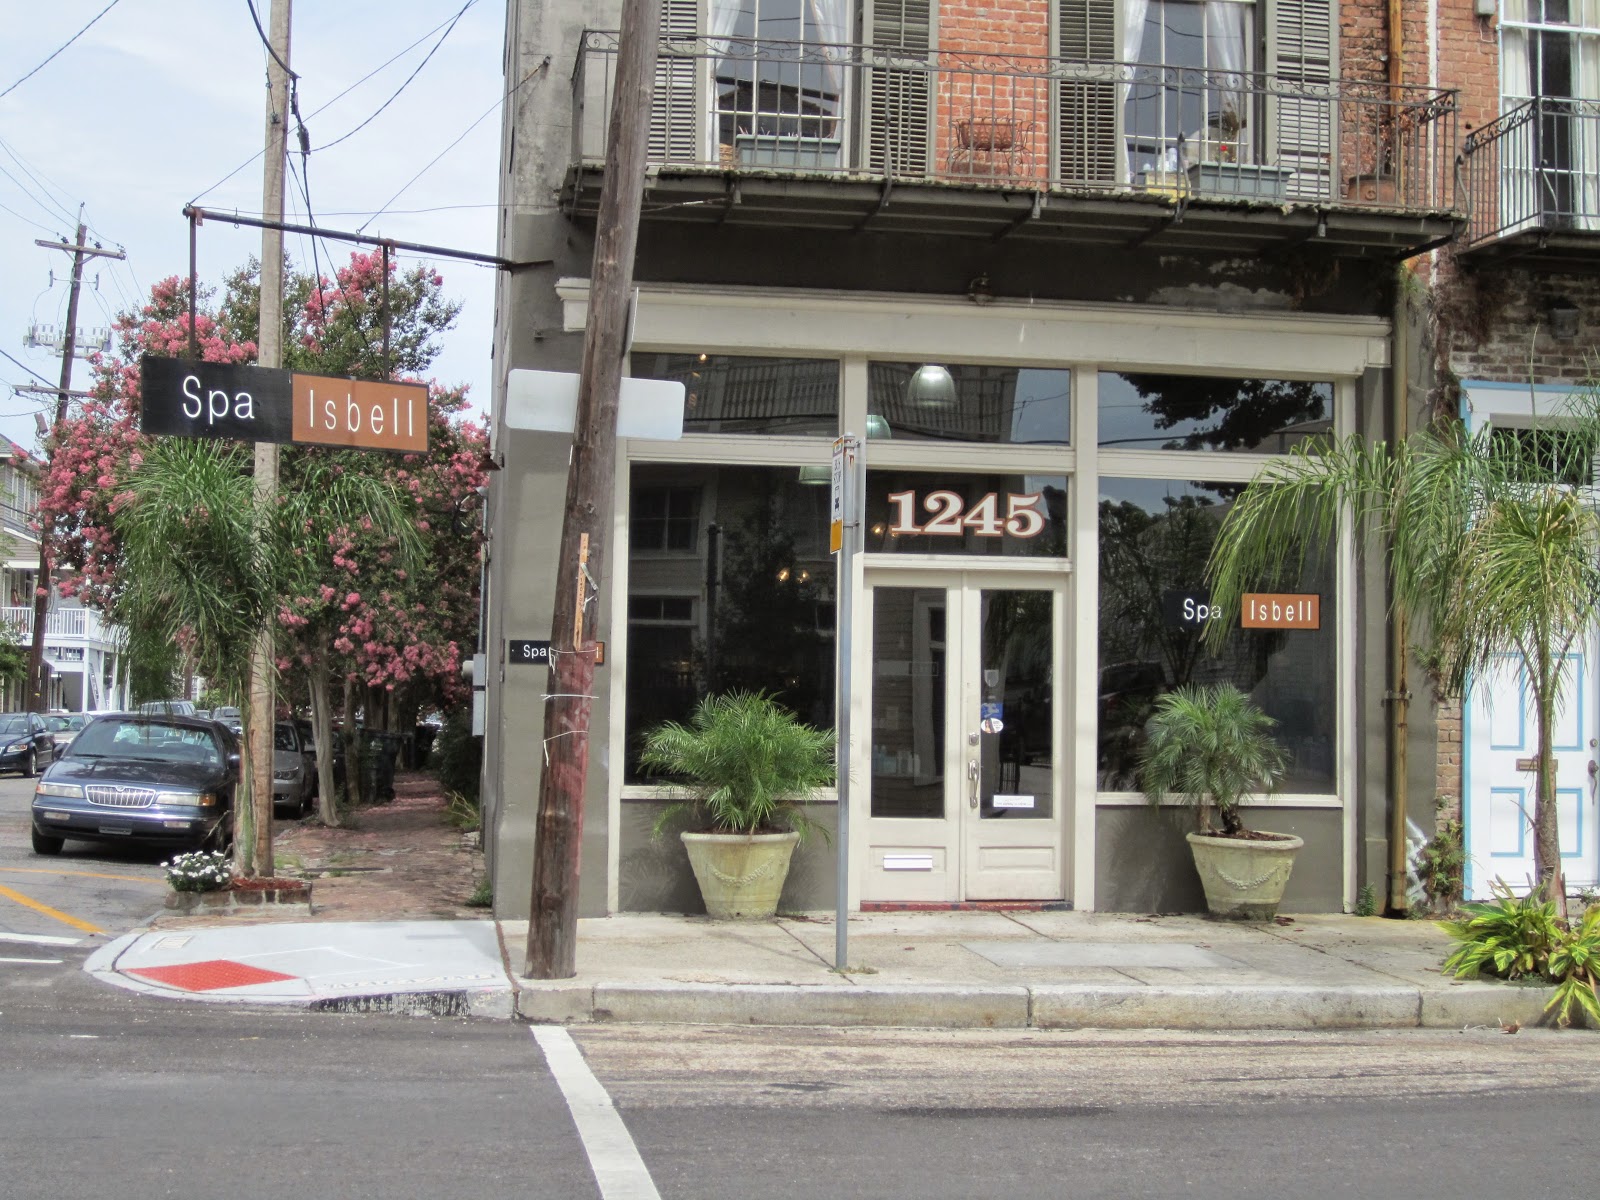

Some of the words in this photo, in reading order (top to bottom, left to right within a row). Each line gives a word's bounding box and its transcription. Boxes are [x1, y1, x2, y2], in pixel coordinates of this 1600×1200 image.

[182, 375, 255, 425] Spa
[308, 389, 414, 438] Isbell
[888, 489, 1046, 539] 1245
[1183, 598, 1222, 623] Spa
[1251, 599, 1312, 622] Isbell
[523, 644, 547, 659] Spa
